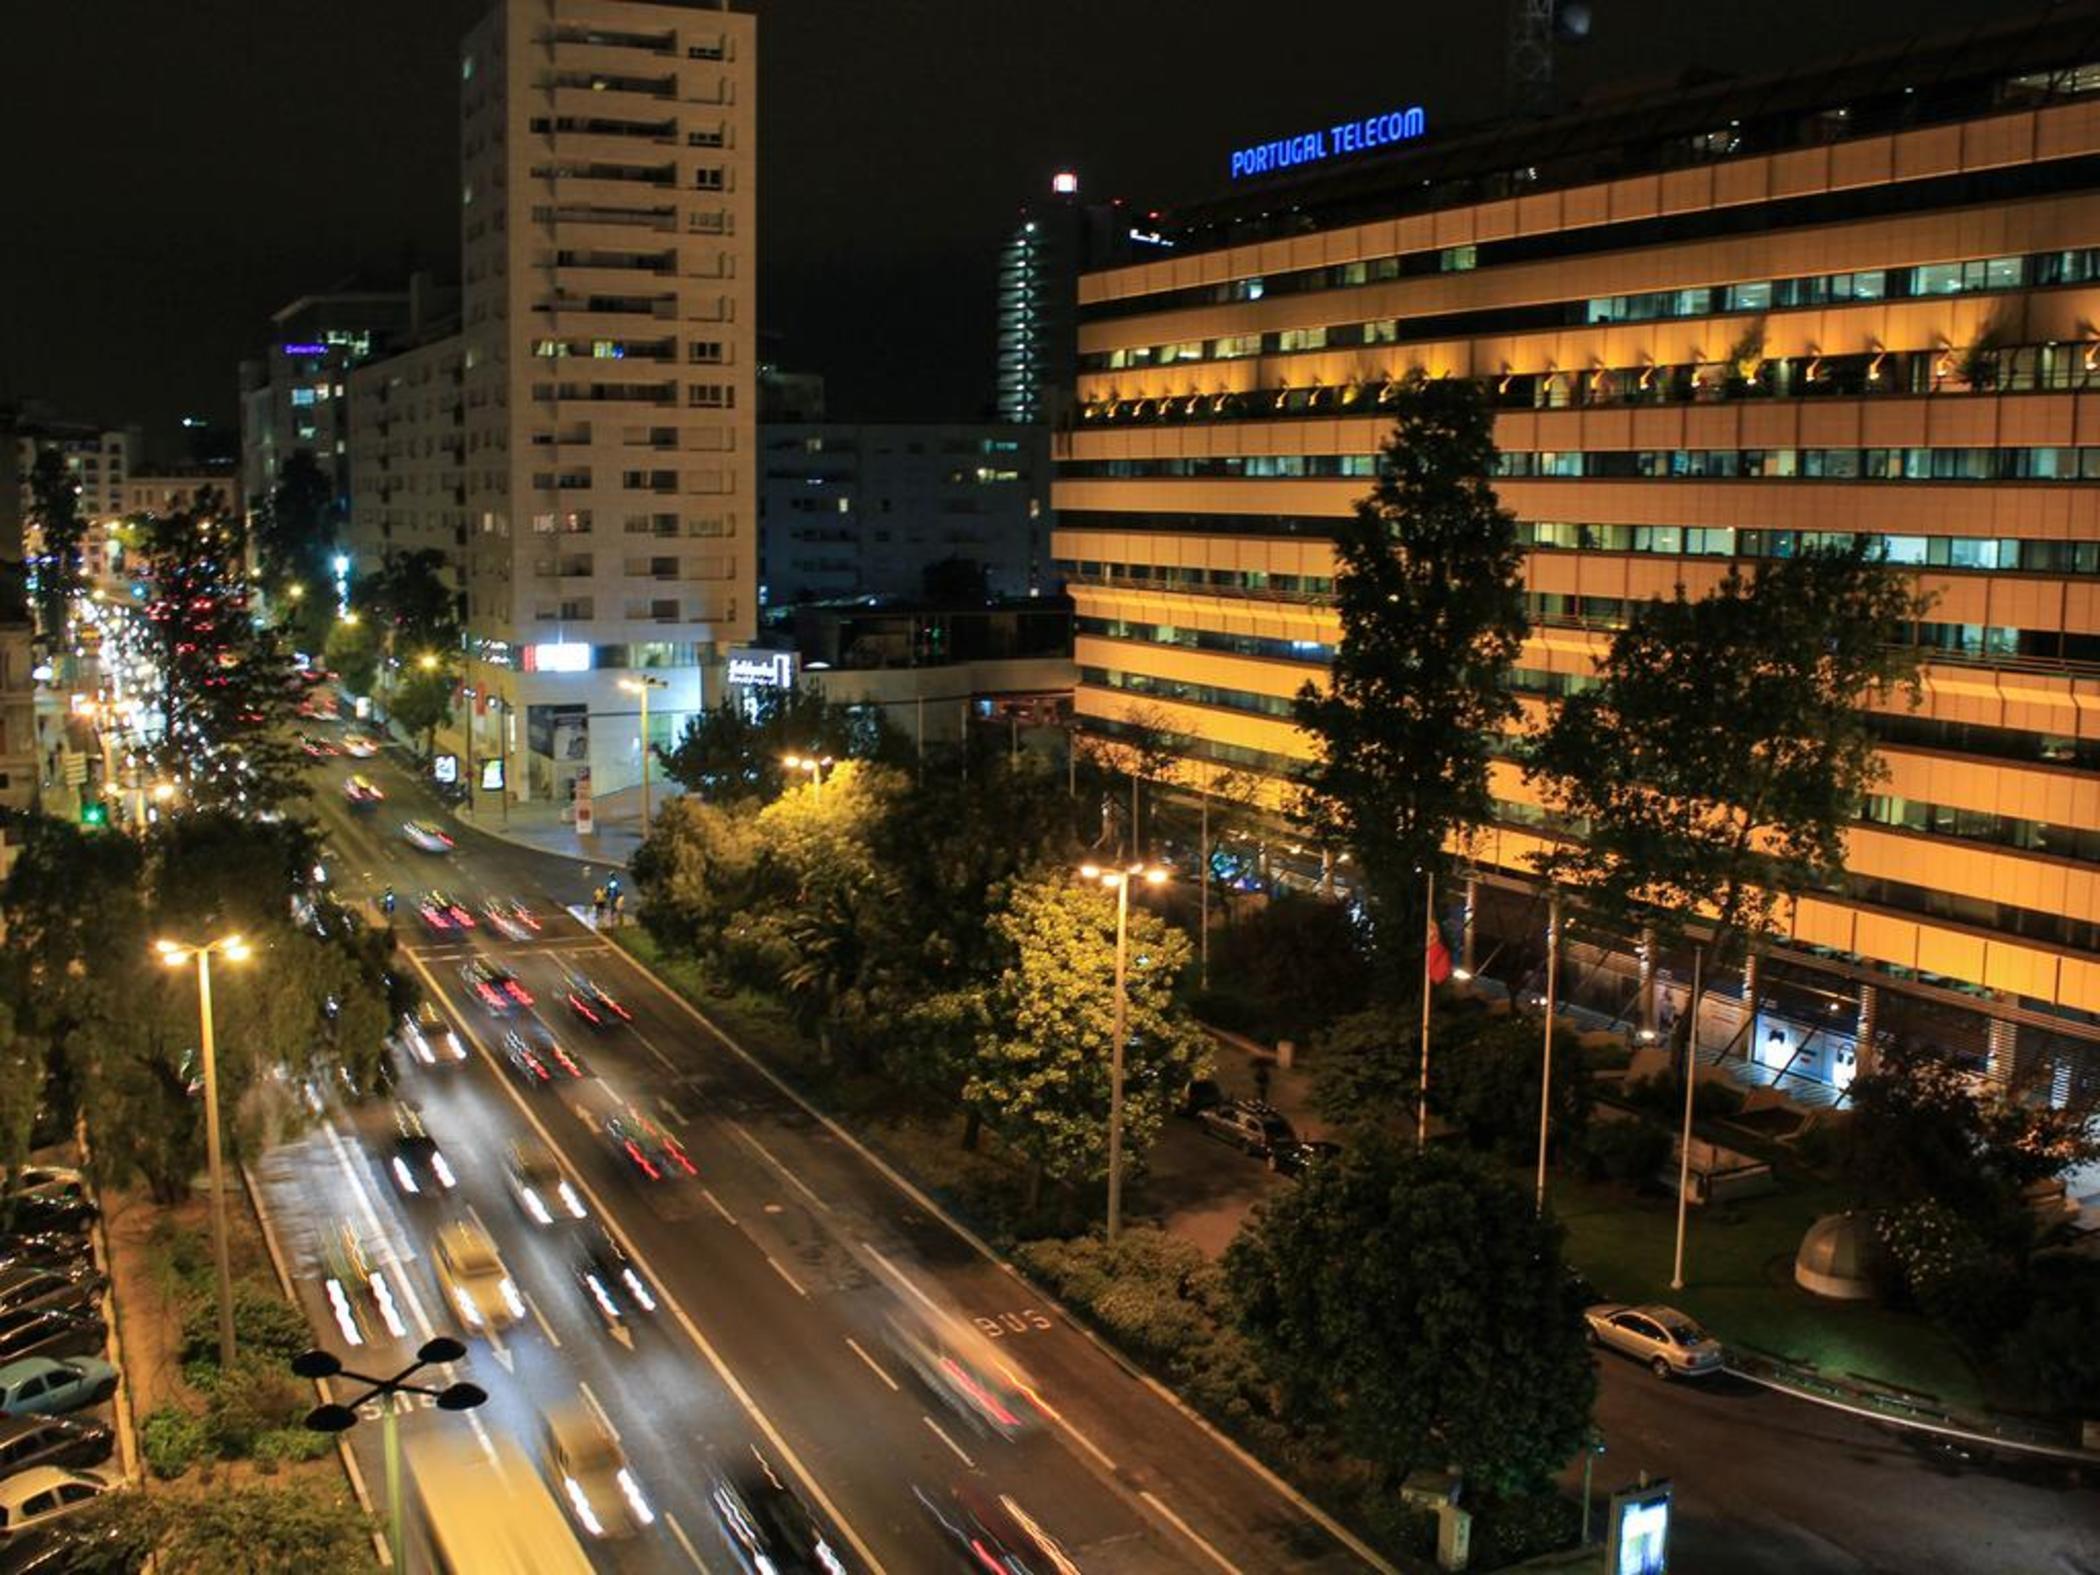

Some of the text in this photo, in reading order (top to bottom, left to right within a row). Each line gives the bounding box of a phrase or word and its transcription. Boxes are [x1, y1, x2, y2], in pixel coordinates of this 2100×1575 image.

[1232, 106, 1425, 178] PORTUGAL TELECOM
[974, 1309, 1051, 1337] BUS
